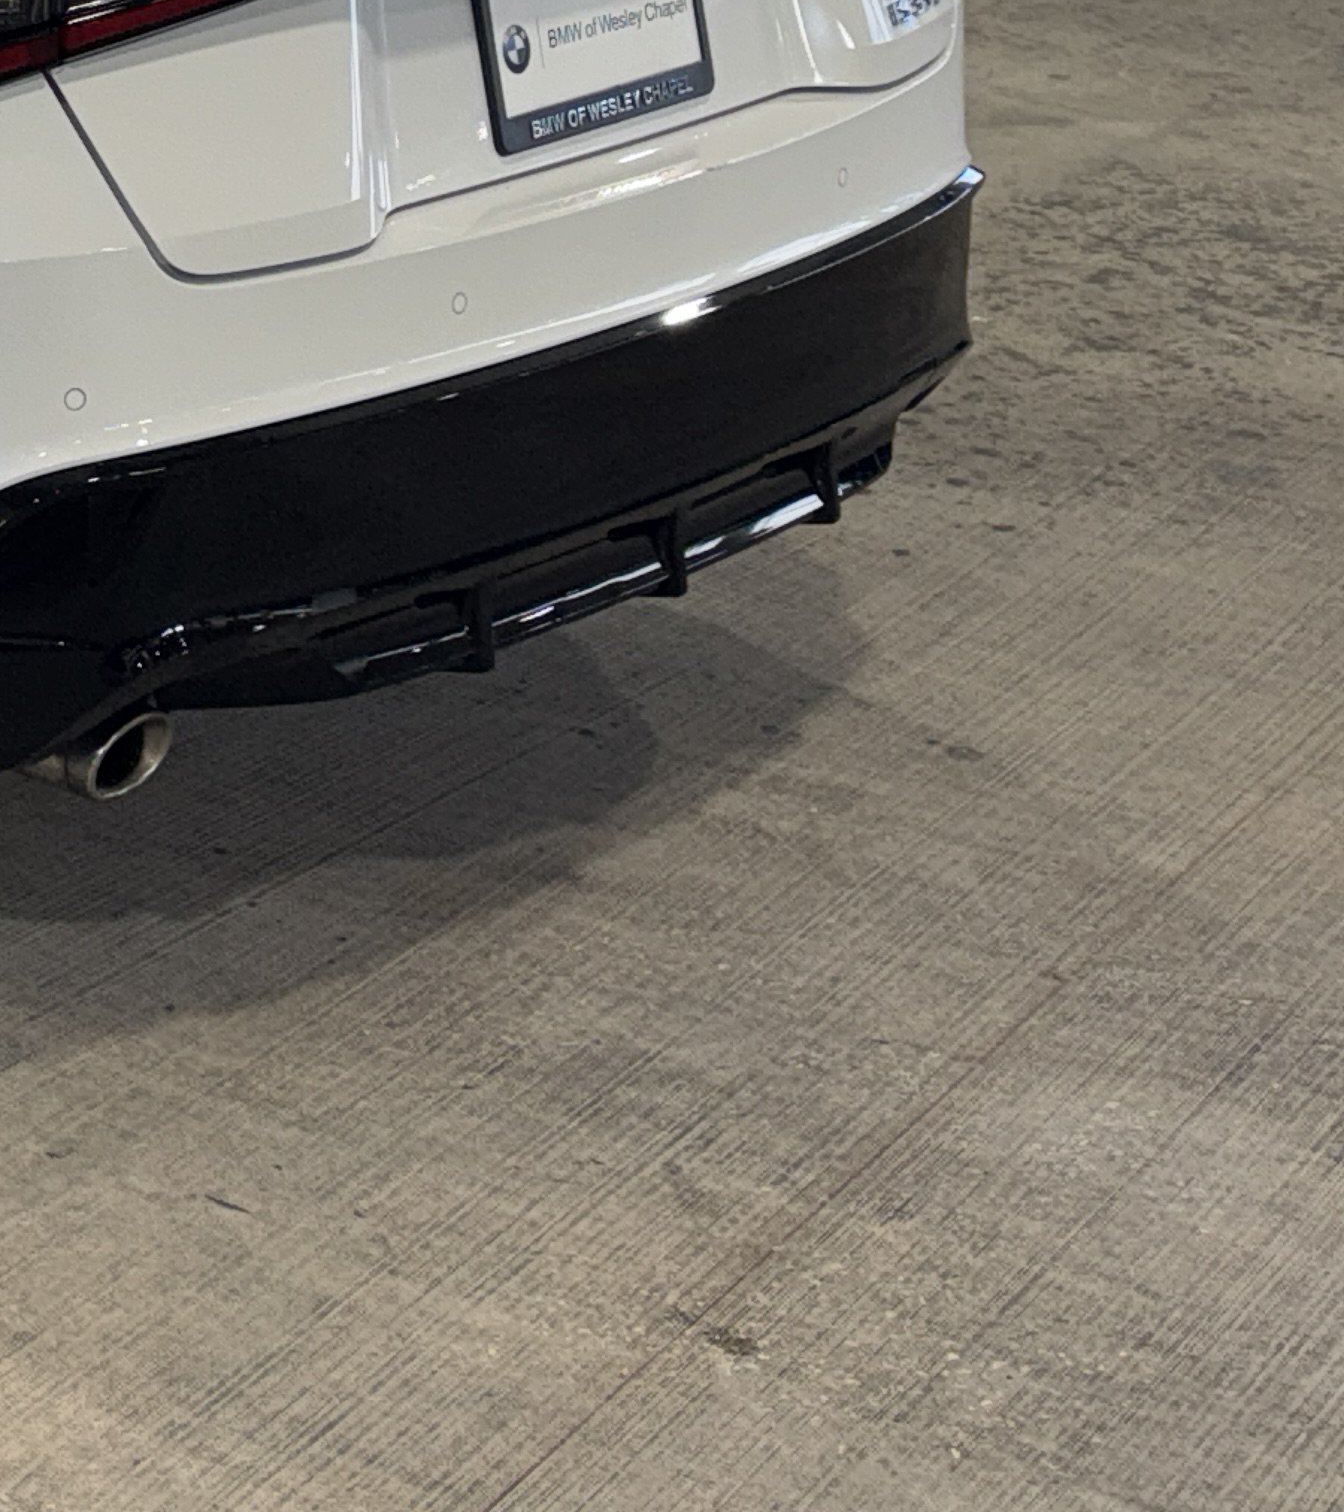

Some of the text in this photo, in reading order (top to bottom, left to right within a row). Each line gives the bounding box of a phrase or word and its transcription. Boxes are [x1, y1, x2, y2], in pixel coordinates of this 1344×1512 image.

[548, 23, 582, 48] BMW
[584, 17, 597, 38] of
[596, 9, 642, 33] Wesley
[531, 76, 694, 139] BMW OF WESLEY CHAPEL
